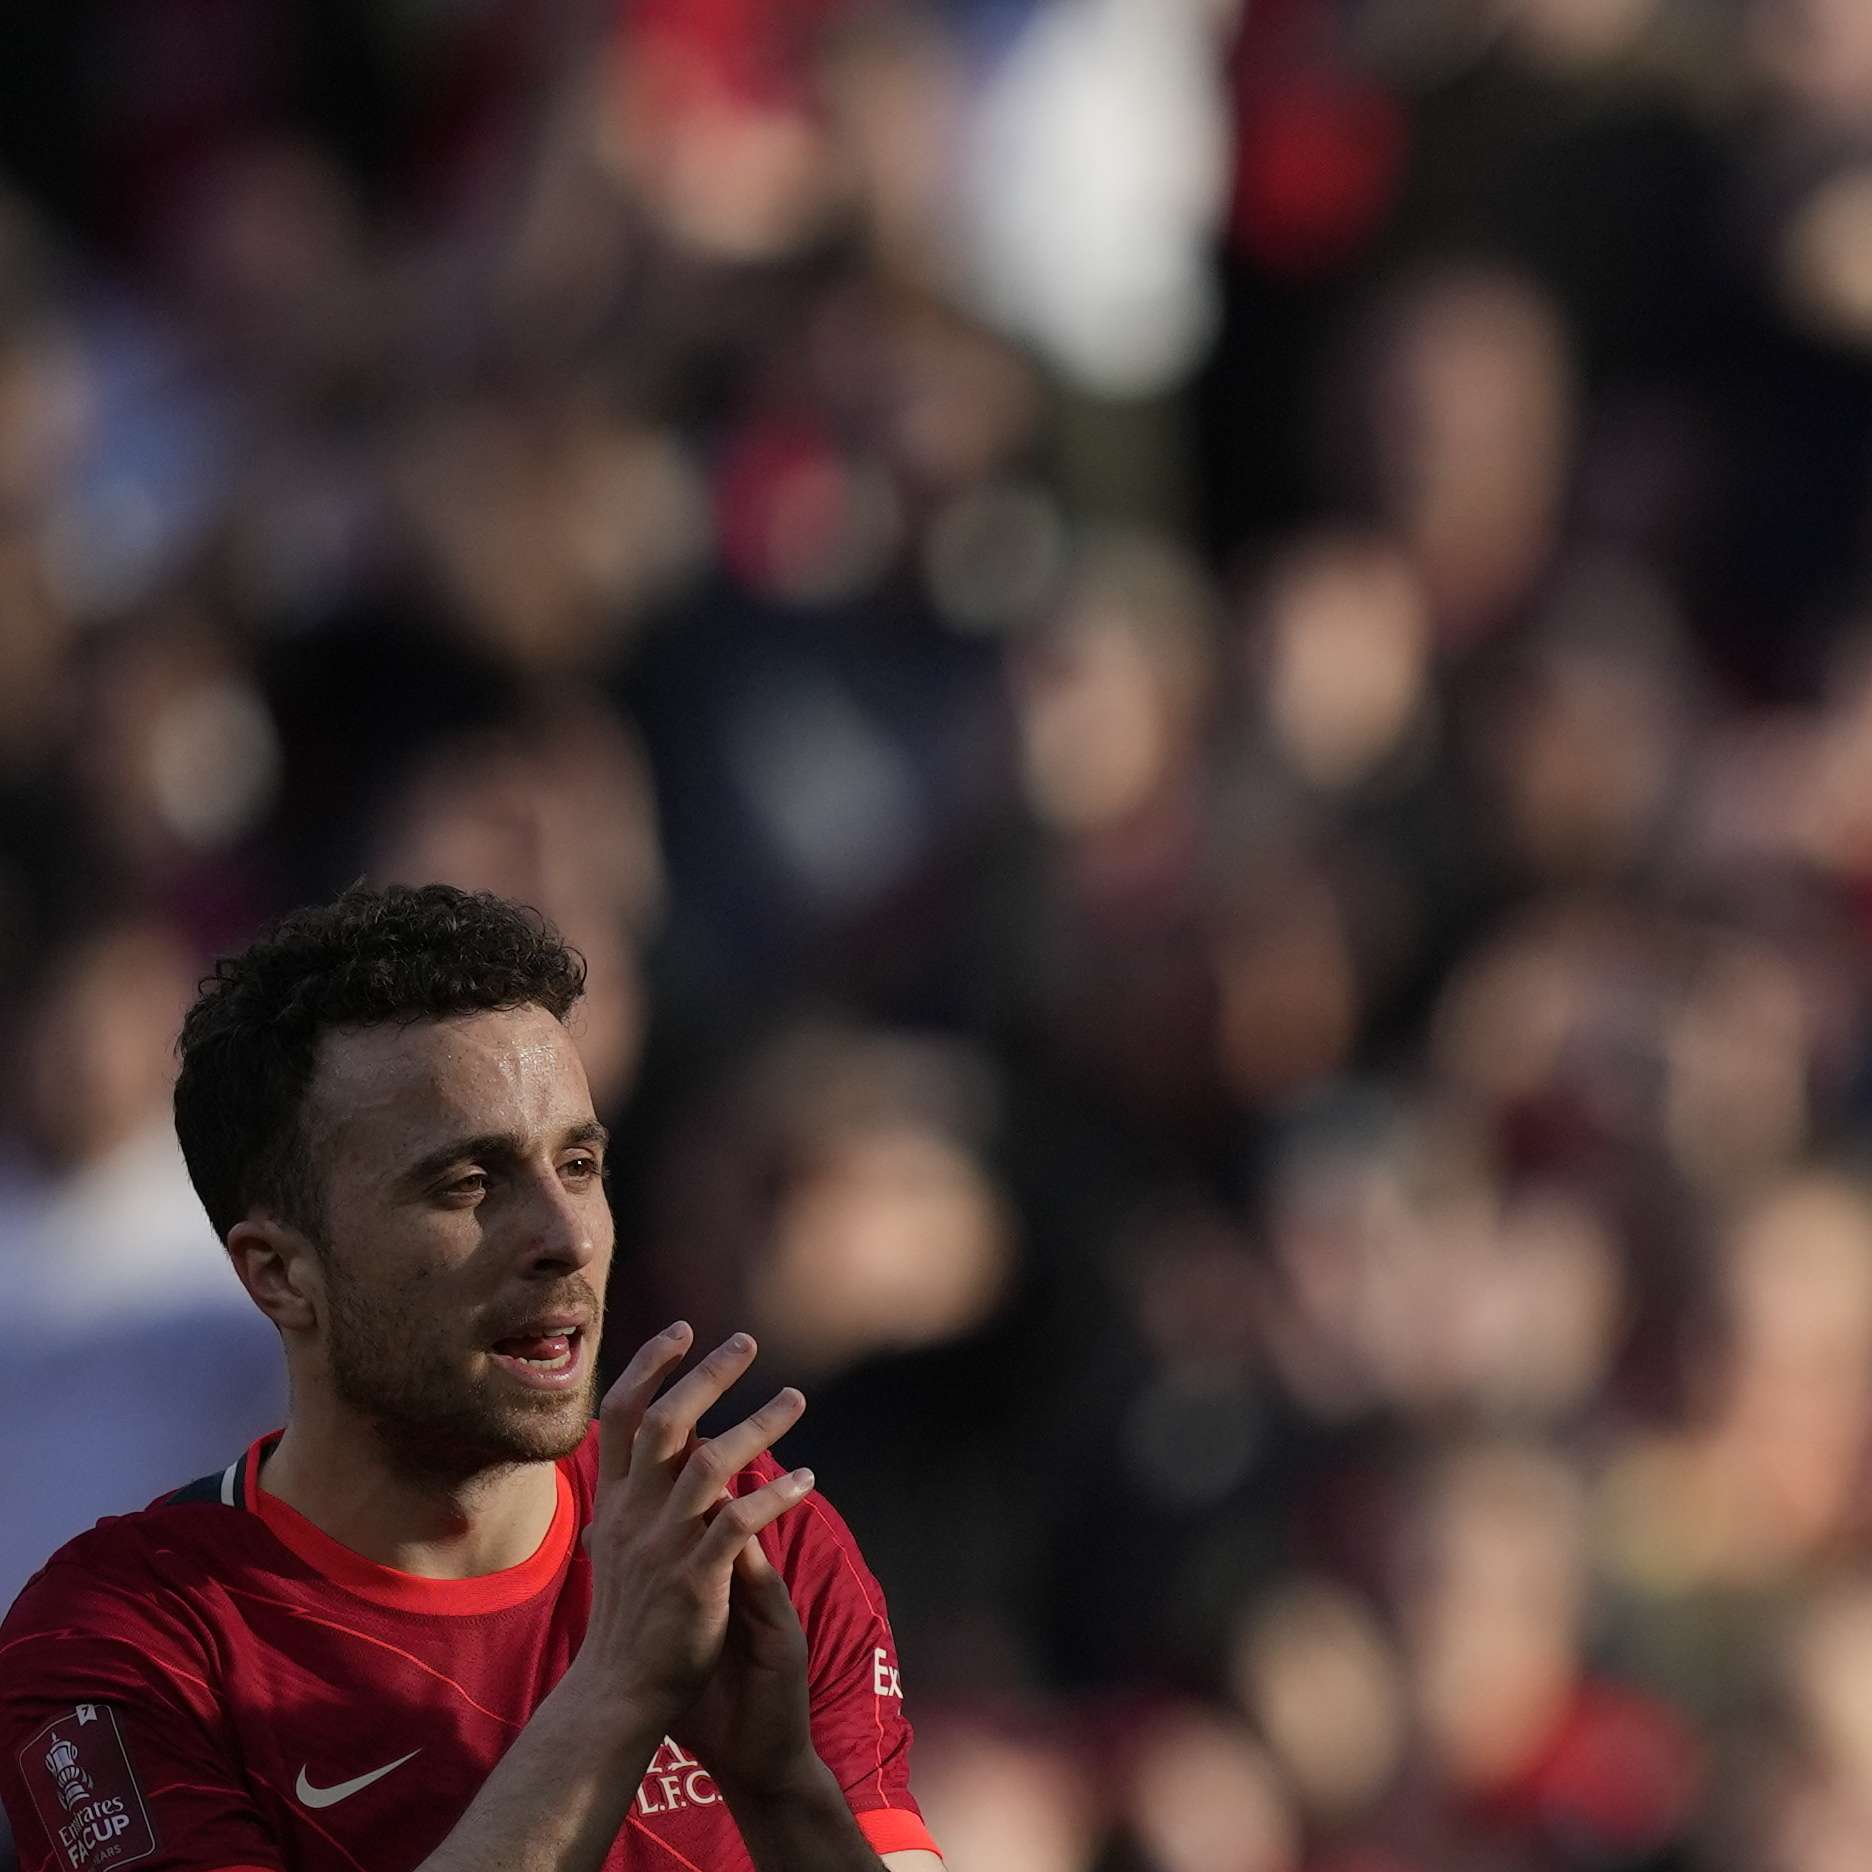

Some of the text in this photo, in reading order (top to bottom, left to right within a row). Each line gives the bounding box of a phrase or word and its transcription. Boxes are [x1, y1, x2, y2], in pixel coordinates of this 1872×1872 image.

[874, 1647, 903, 1699] Ex
[635, 1769, 723, 1815] L.F.C.
[68, 1814, 130, 1870] FA CUP
